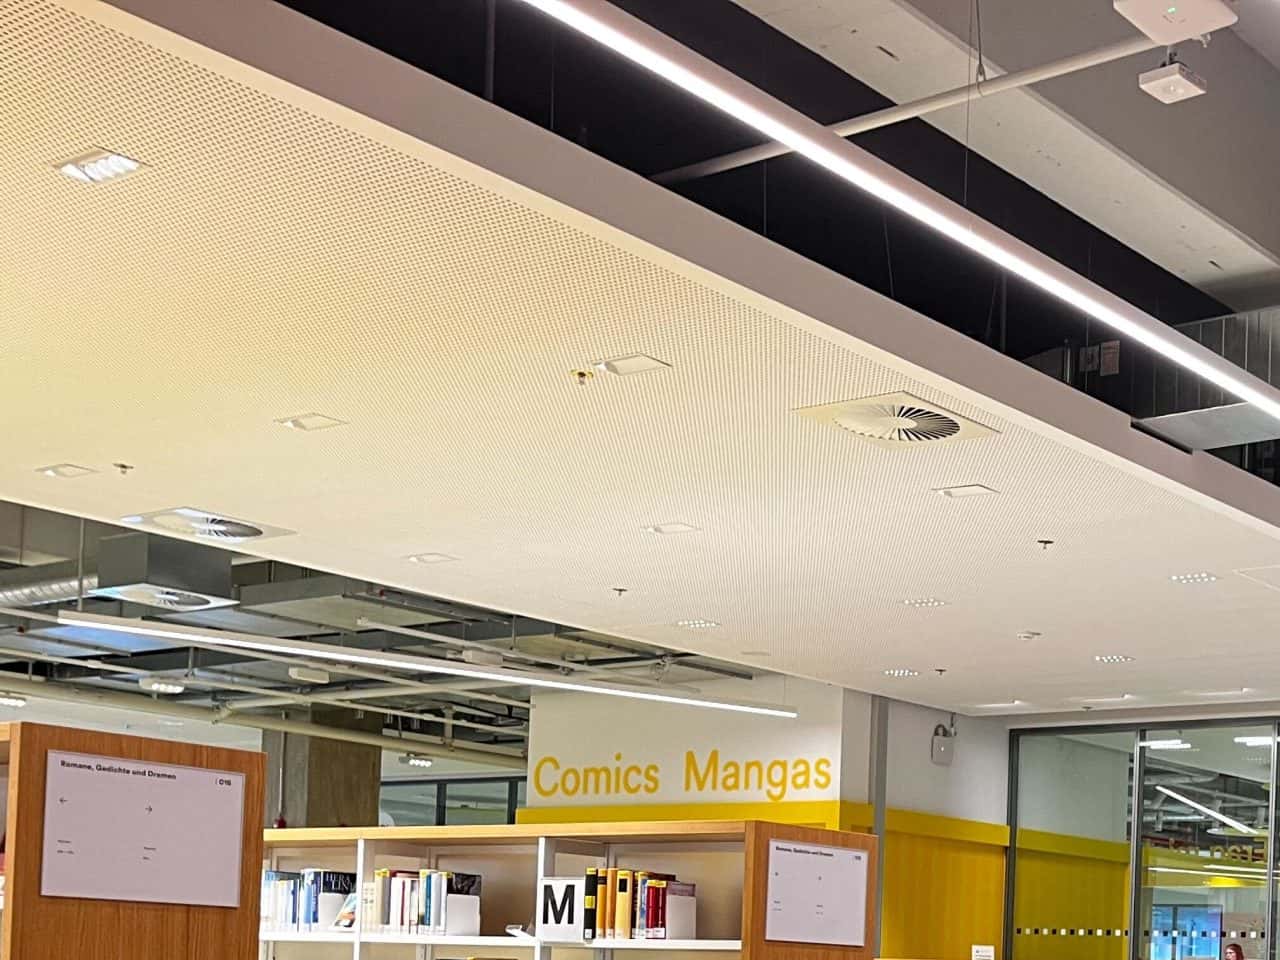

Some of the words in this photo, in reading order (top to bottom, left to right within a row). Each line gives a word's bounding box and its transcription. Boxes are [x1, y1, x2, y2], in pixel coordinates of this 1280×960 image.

[95, 763, 131, 775] Gedichte
[131, 769, 147, 778] und
[147, 770, 178, 781] Dramen
[532, 752, 661, 798] Comics
[683, 749, 832, 801] Mangas
[542, 884, 575, 925] M
